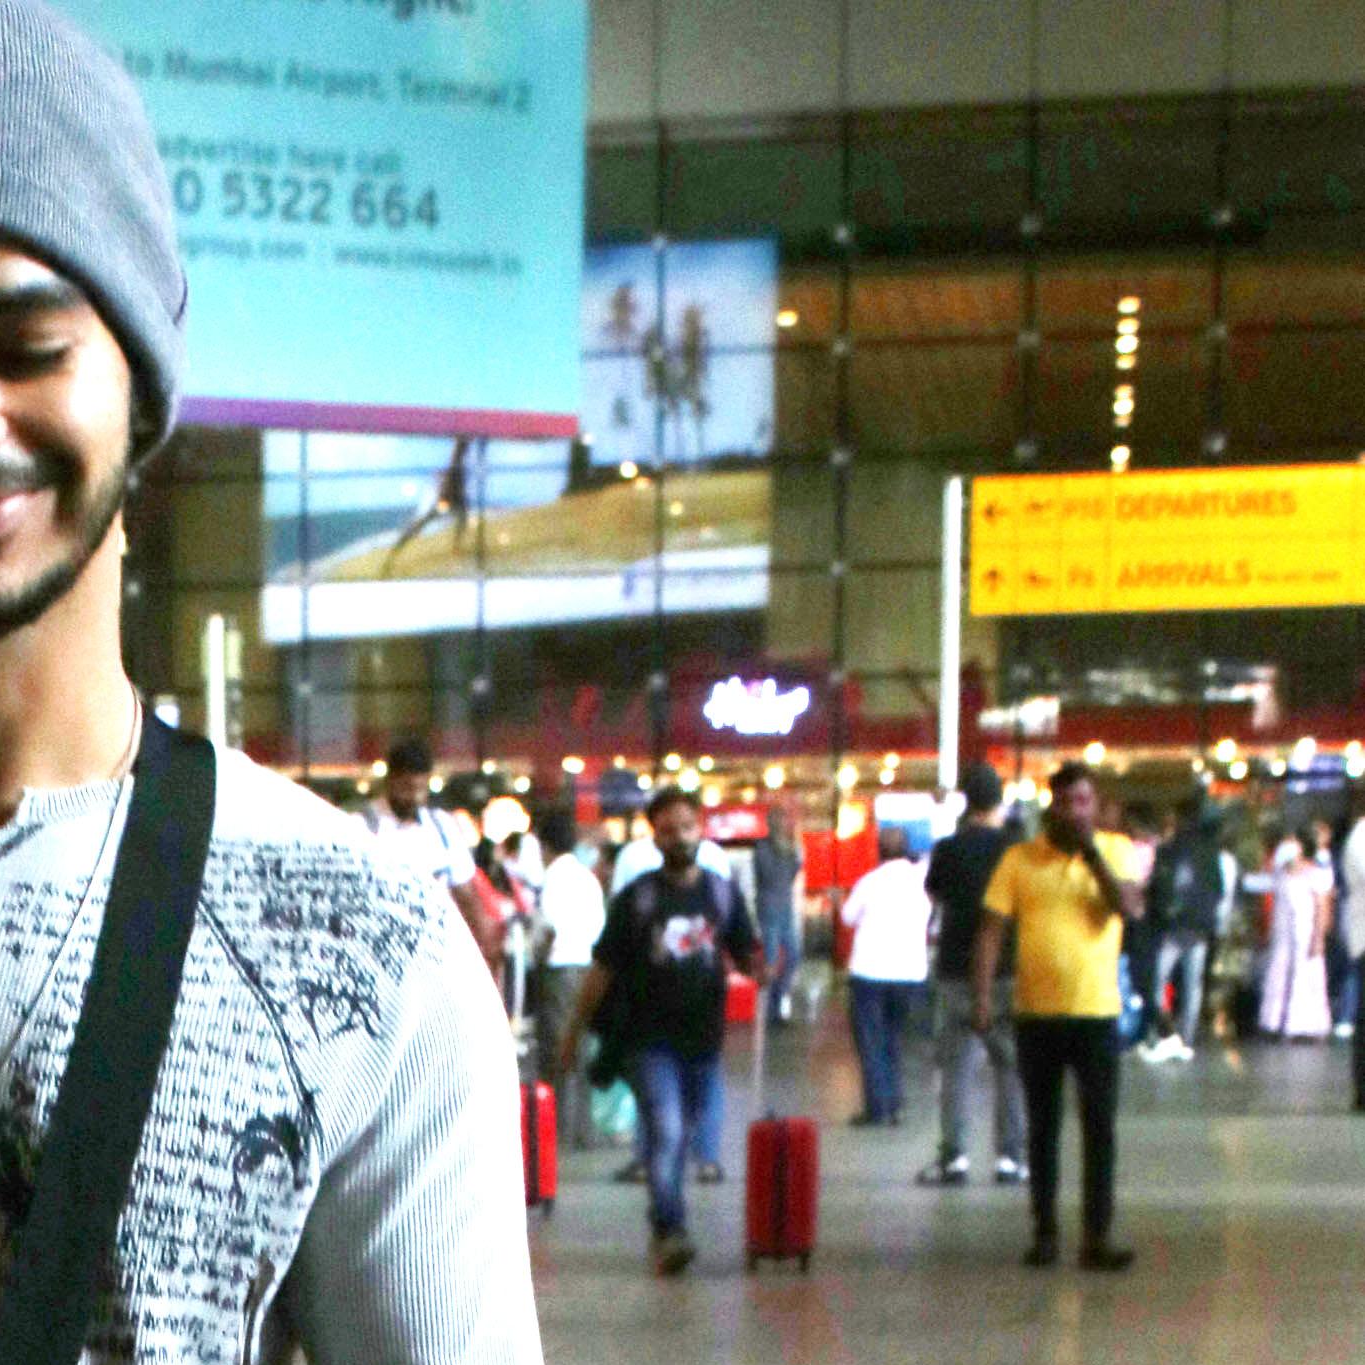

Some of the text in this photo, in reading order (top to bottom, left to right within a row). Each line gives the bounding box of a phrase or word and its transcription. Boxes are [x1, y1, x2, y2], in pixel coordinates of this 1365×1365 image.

[222, 170, 333, 225] 5322
[349, 180, 441, 231] 664
[1117, 491, 1297, 521] DEPARTURES
[1116, 558, 1251, 589] ARRIVALS
